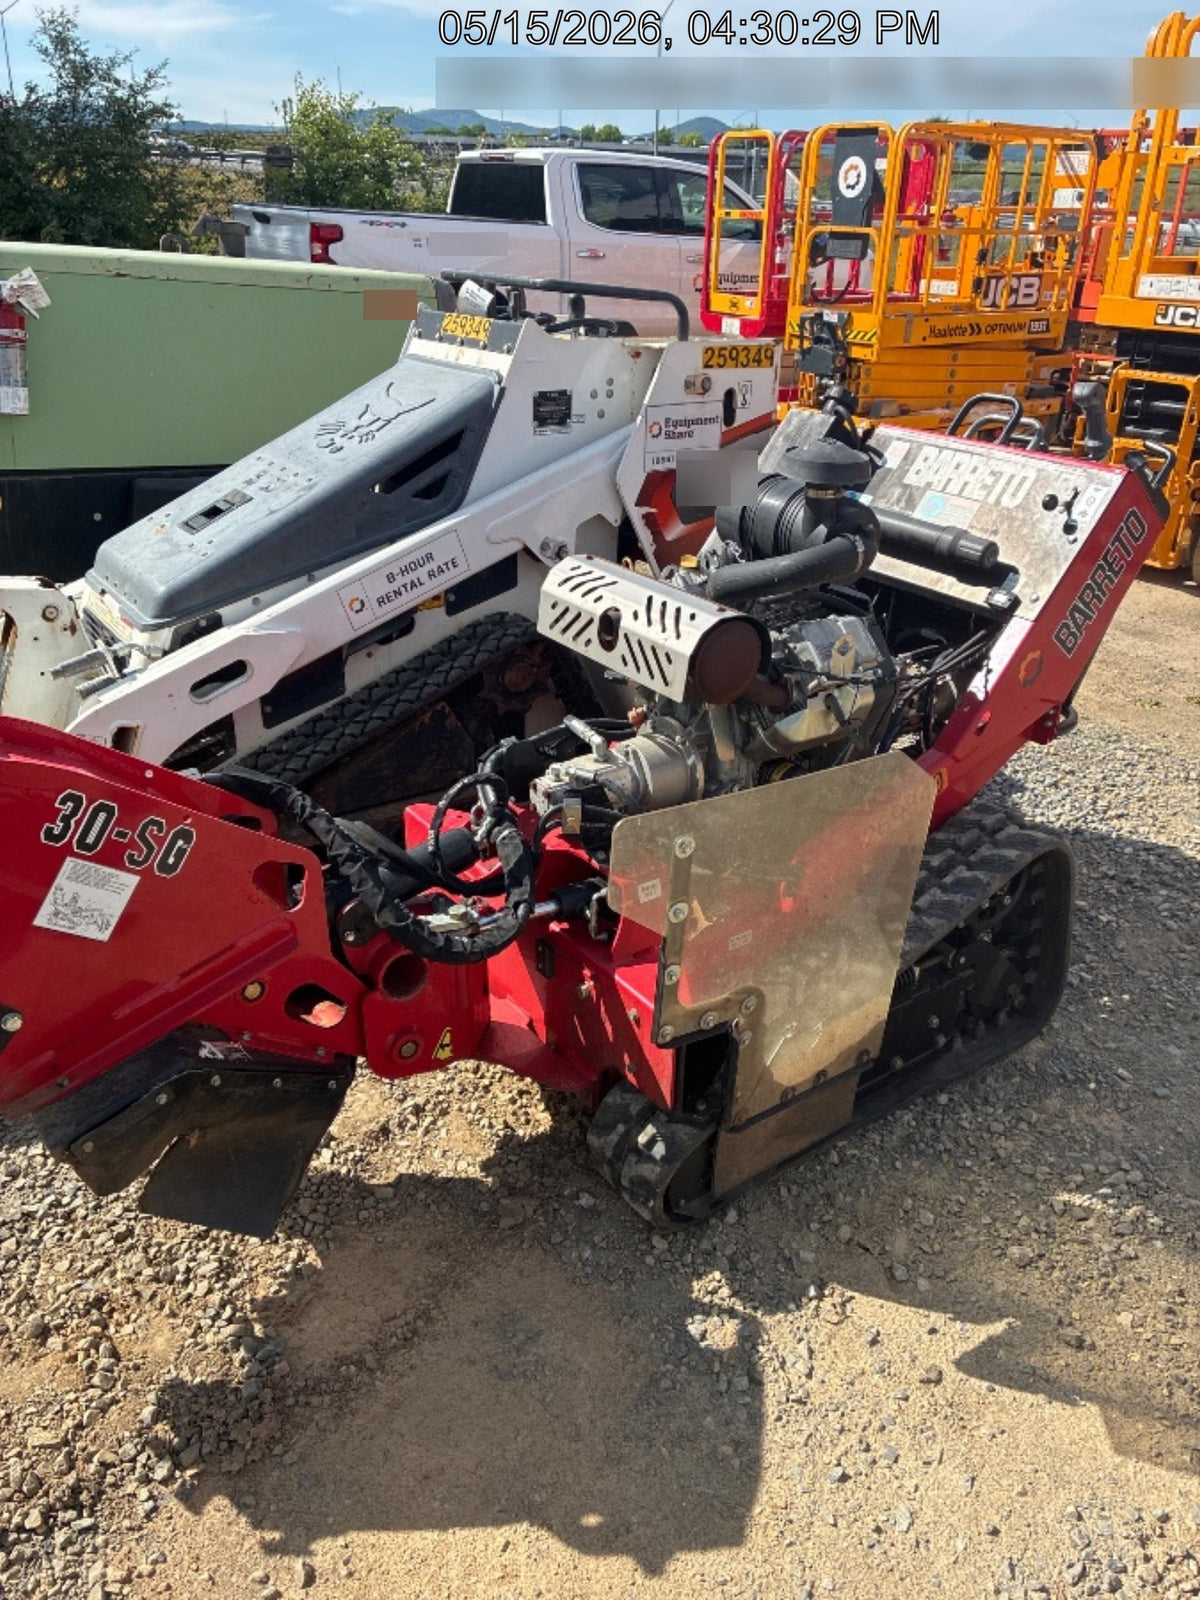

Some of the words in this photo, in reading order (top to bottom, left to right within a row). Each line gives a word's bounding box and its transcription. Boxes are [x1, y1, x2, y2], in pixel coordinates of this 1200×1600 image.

[981, 275, 1041, 308] JCB
[442, 313, 491, 337] 259349
[1155, 304, 1200, 328] JC
[703, 345, 775, 369] 259349
[663, 415, 719, 430] Equipment
[663, 430, 694, 441] Share
[902, 444, 1037, 509] BARRETO
[376, 577, 425, 607] RENTAL
[427, 556, 459, 581] RATE
[386, 551, 434, 584] 8-HOUR
[1052, 506, 1148, 658] BARRETO
